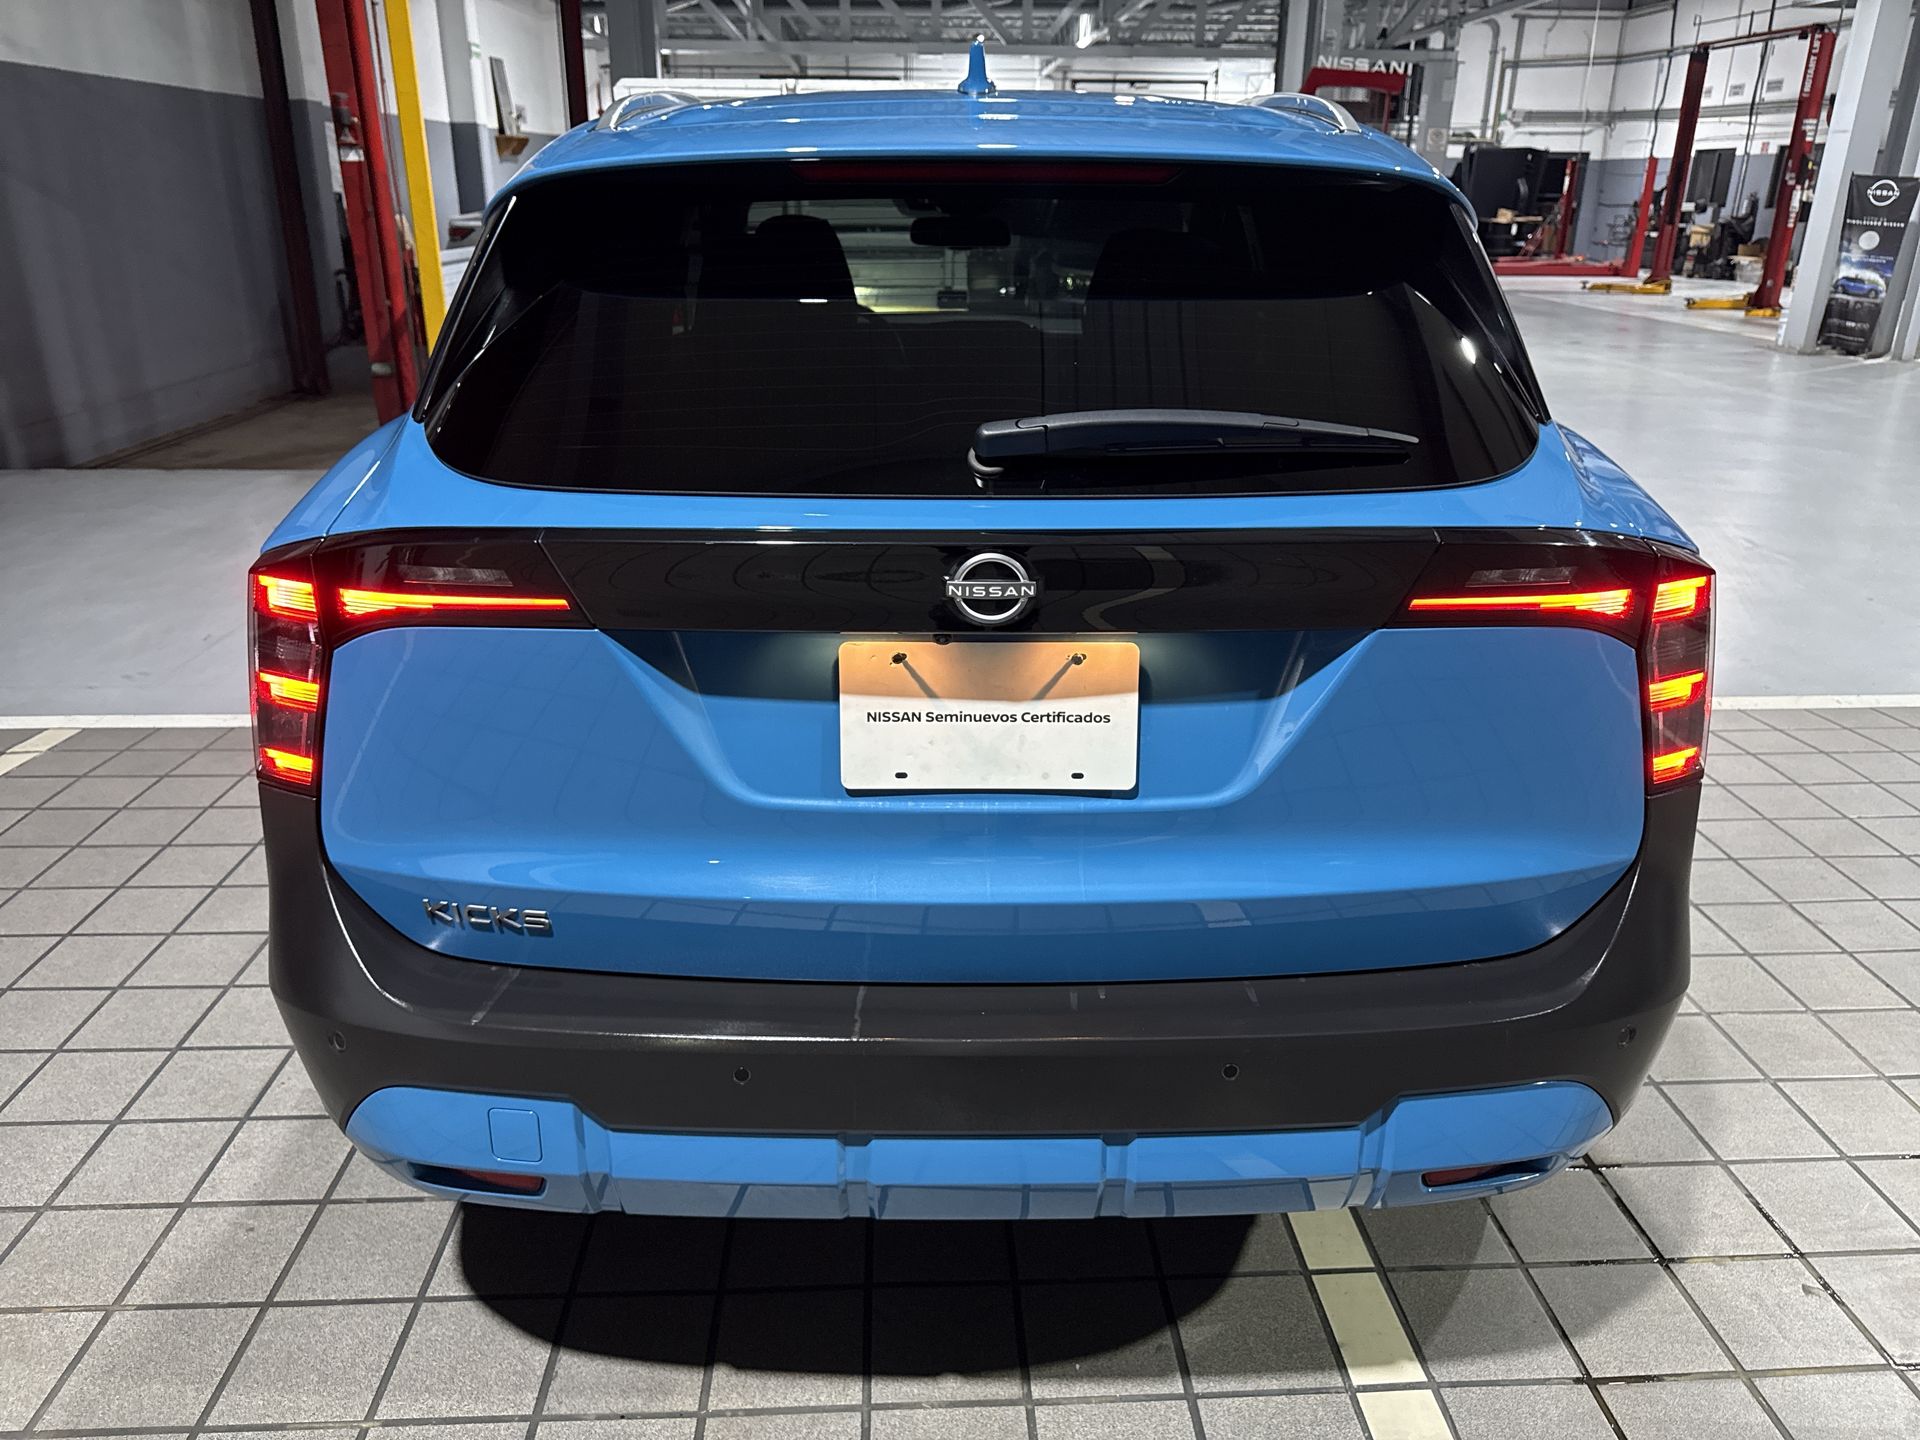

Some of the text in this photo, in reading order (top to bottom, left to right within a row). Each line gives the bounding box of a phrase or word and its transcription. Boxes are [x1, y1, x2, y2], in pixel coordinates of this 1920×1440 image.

[1317, 54, 1406, 75] NISSAN
[1867, 188, 1900, 199] NISSAN
[948, 585, 1034, 597] NISSAN
[866, 710, 1111, 724] NISSAN Seminuevos Certificados
[422, 898, 552, 929] KICKS
